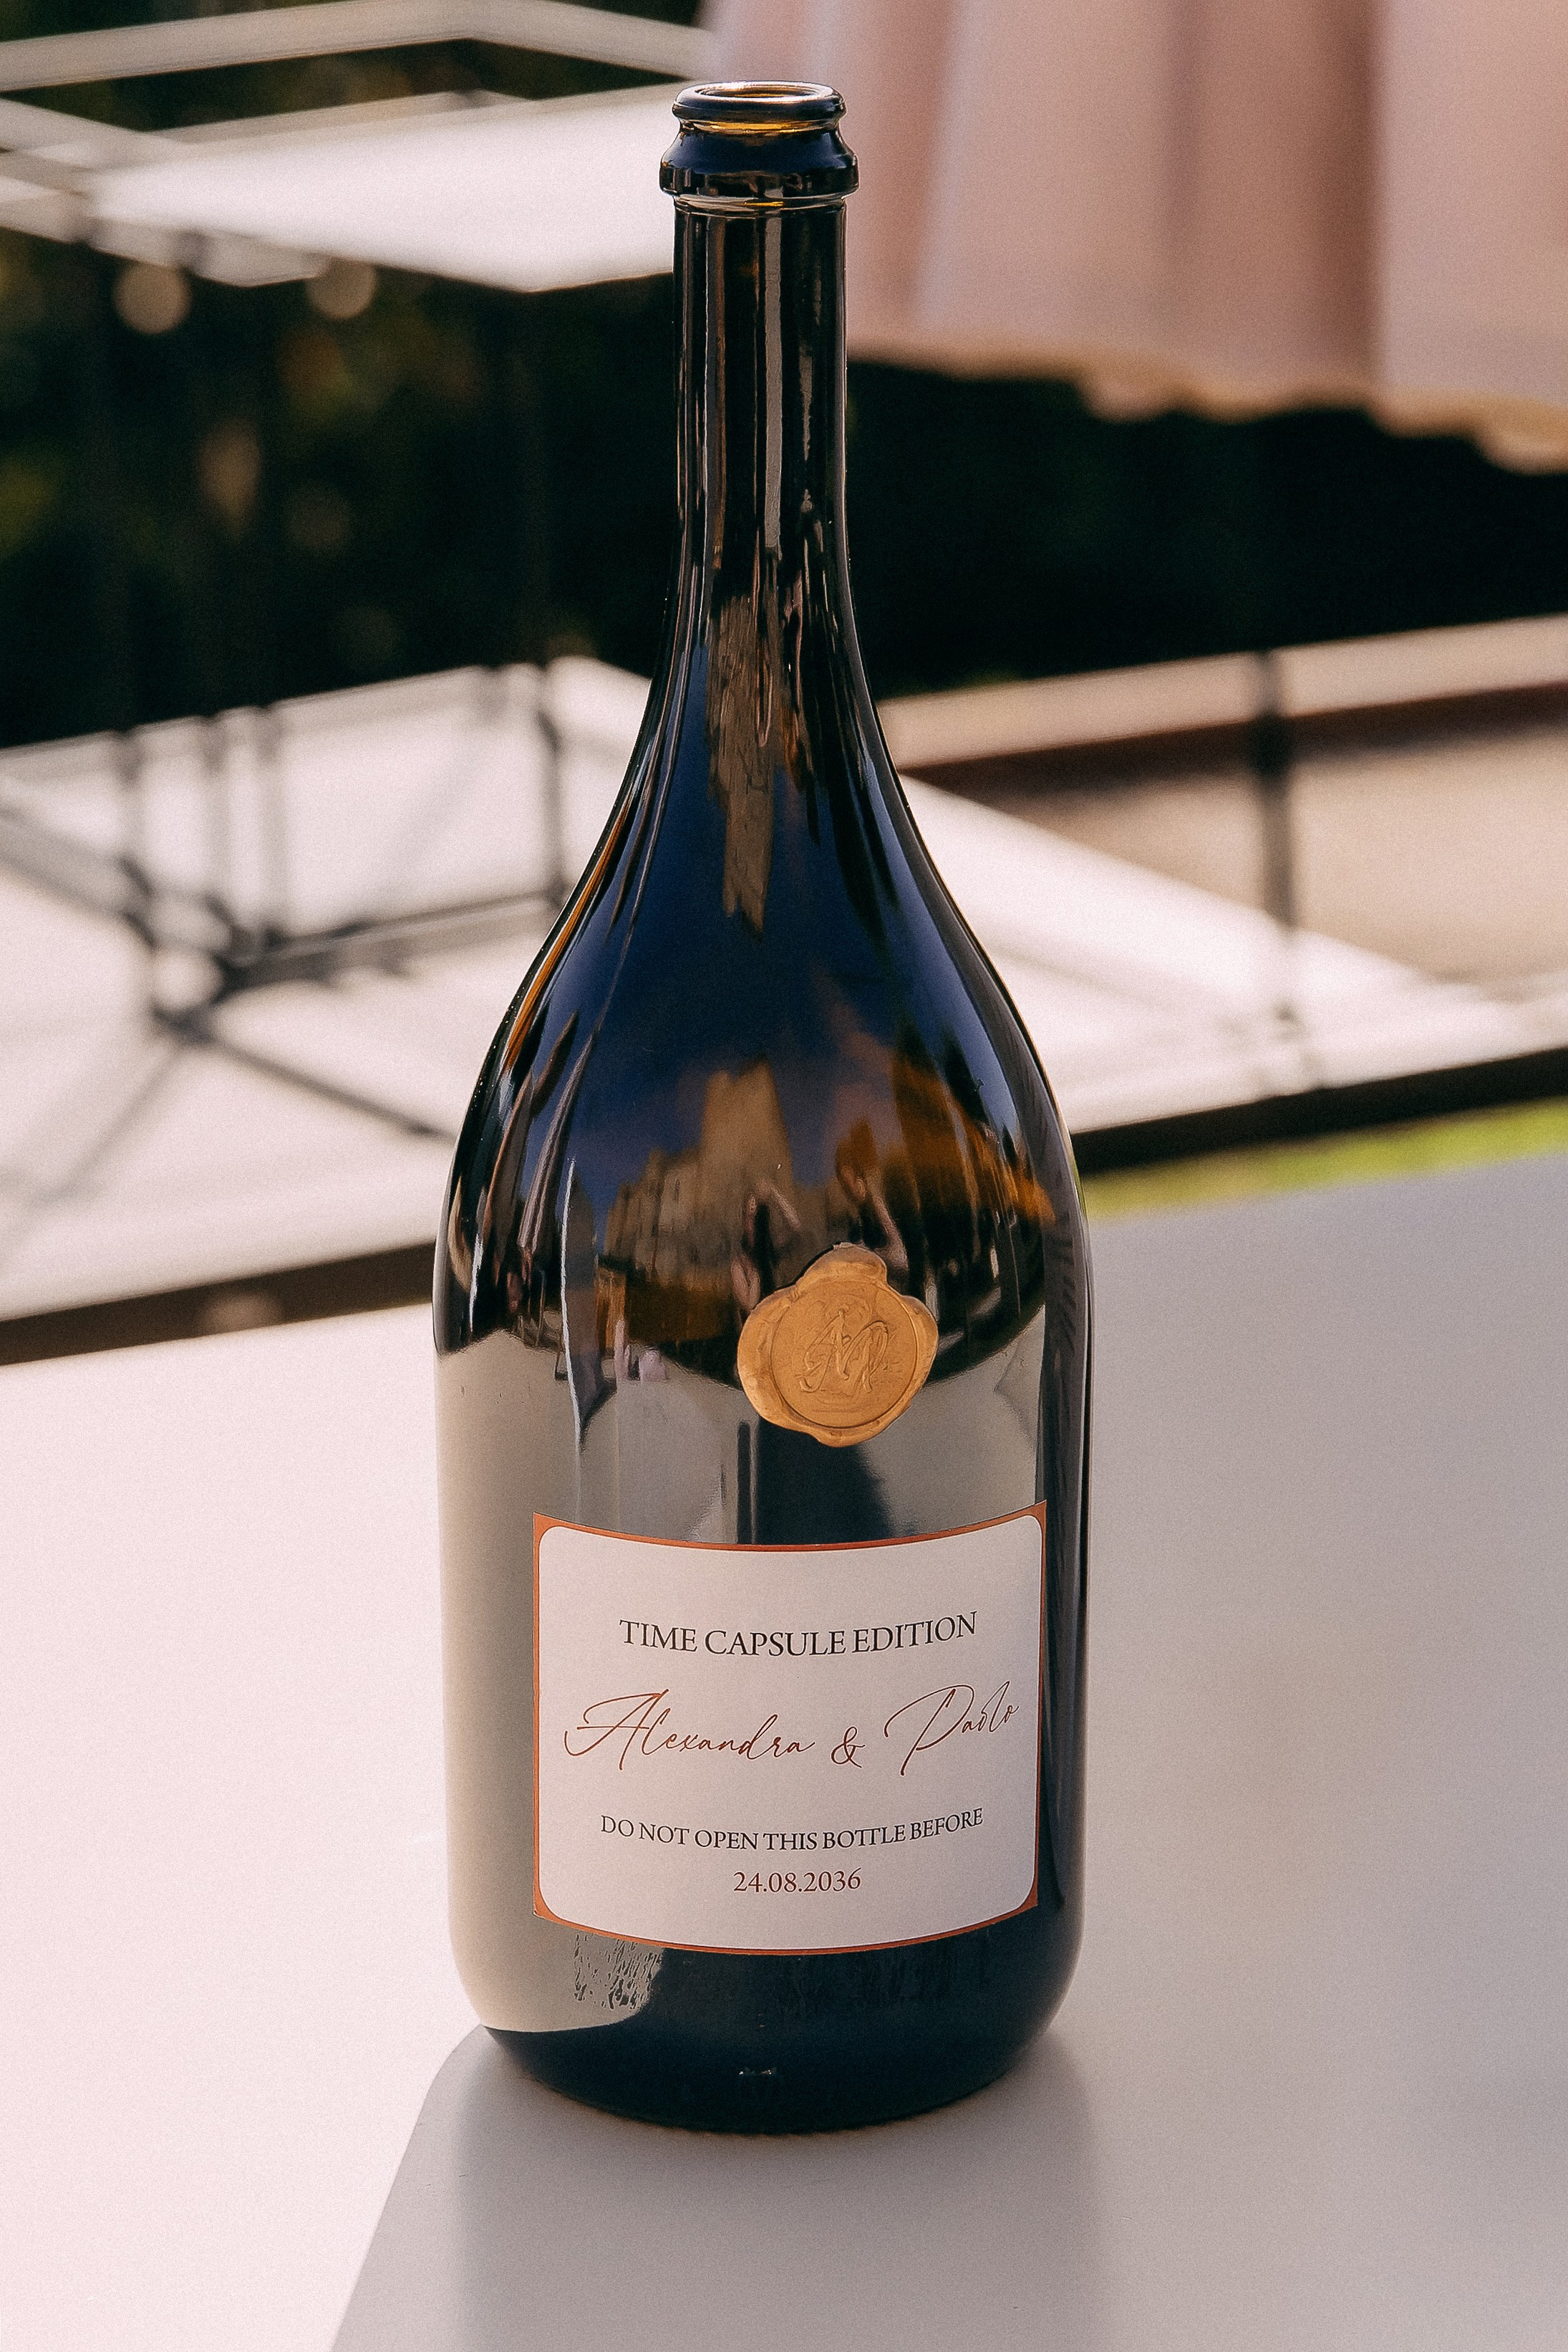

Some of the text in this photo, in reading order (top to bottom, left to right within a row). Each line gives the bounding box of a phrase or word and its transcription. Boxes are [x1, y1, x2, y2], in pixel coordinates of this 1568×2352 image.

[619, 1610, 977, 1657] TIME CAPSULE EDITION
[563, 1680, 1020, 1776] Alexandra & Paolo
[601, 1807, 983, 1851] DO NOT OPEN THIS BOTTLE BEFORE
[733, 1867, 862, 1894] 24.08.2036
